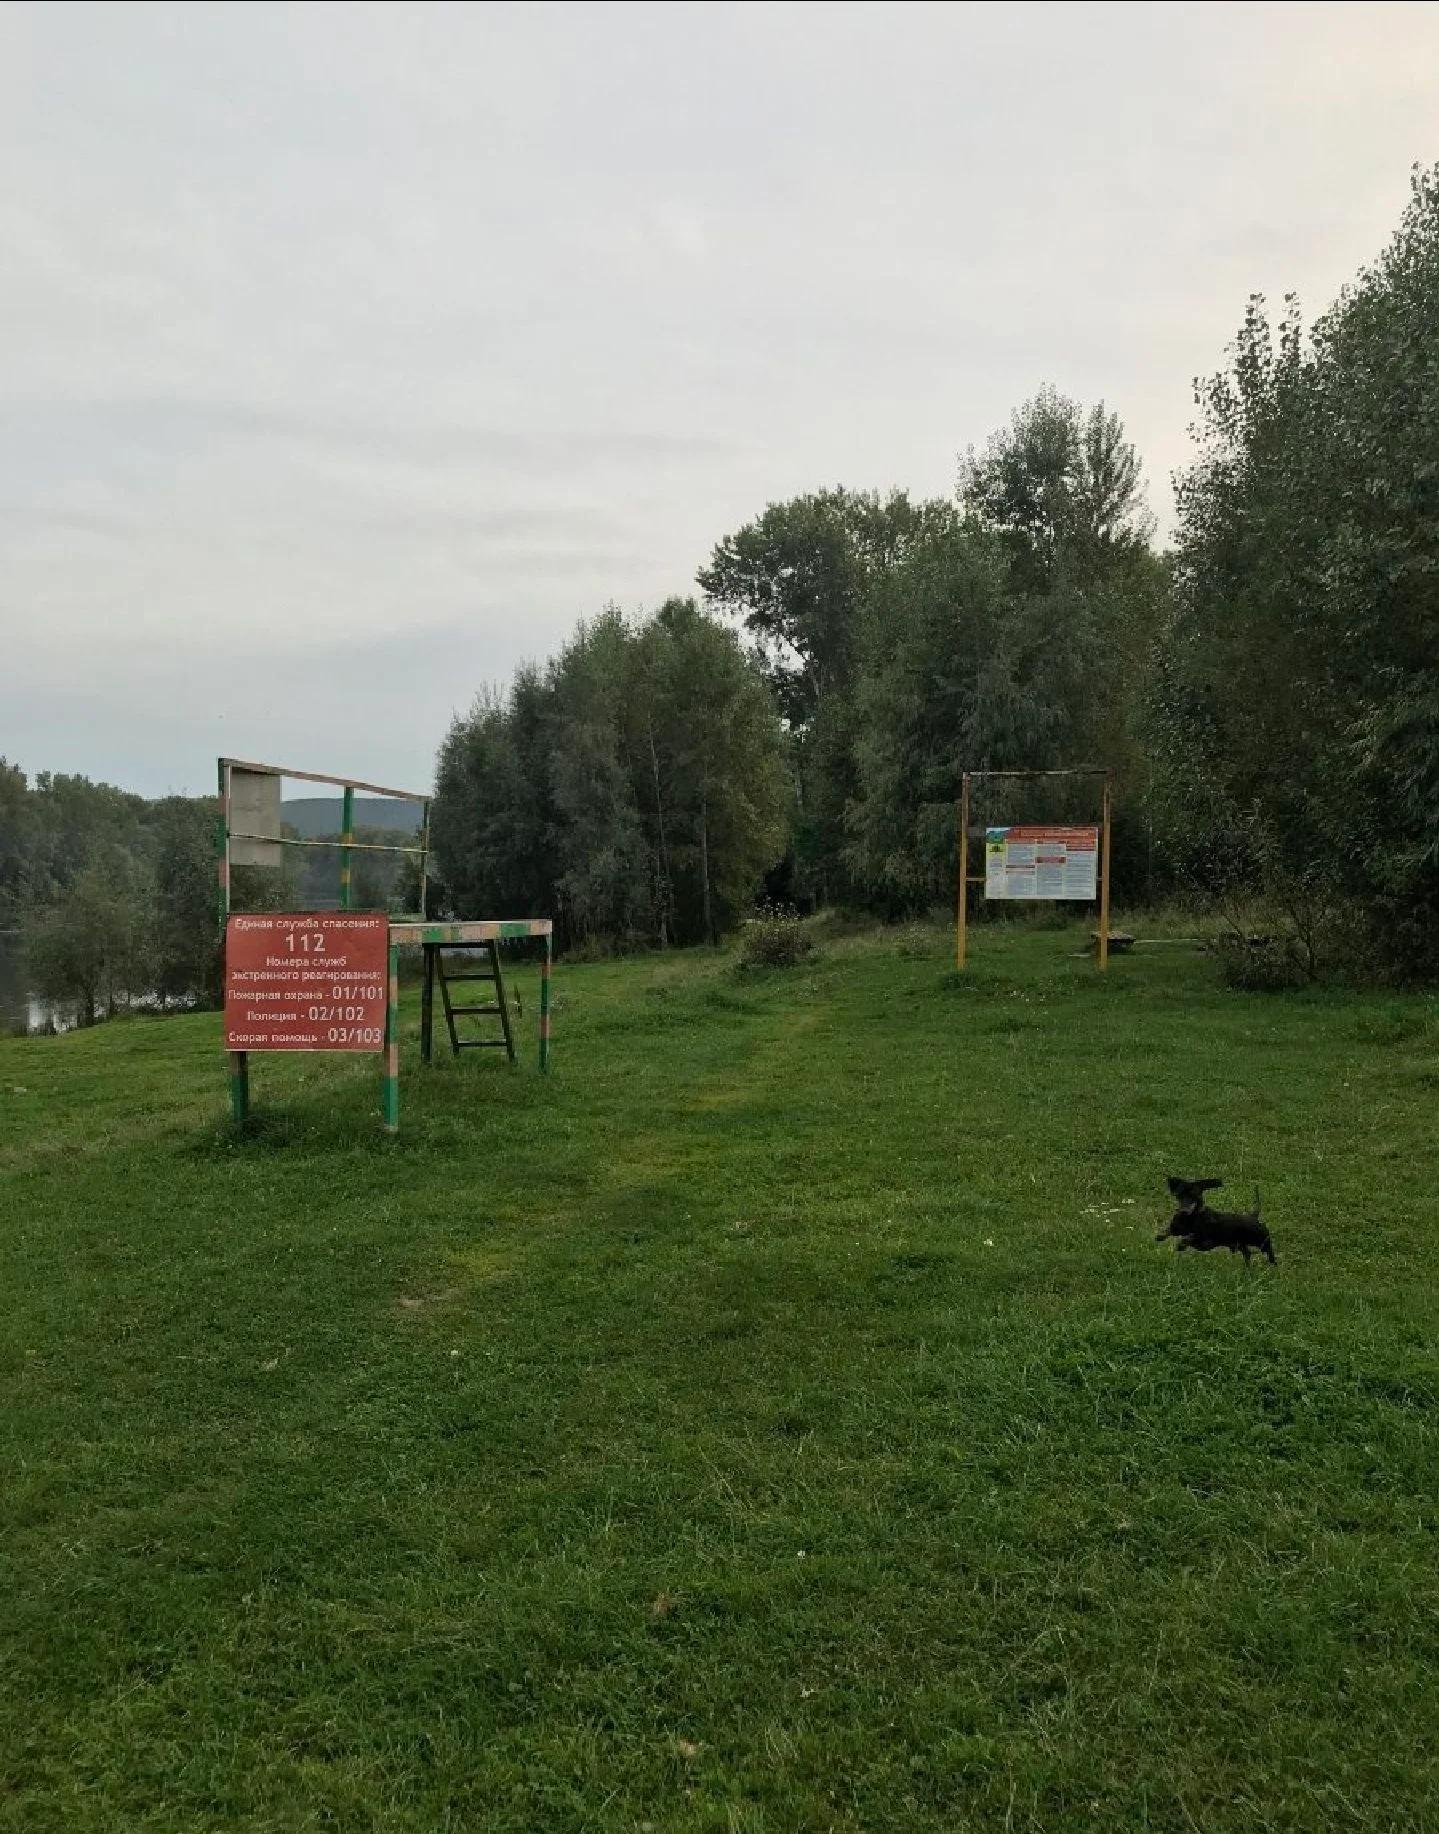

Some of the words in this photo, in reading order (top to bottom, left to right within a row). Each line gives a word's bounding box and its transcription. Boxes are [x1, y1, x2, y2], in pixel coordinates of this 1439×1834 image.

[234, 918, 272, 931] Единая
[276, 918, 318, 931] служба
[323, 920, 379, 928] спасения:
[285, 934, 326, 952] 112
[266, 956, 309, 968] Номера
[312, 956, 347, 968] служб
[232, 972, 299, 982] экстренного
[228, 989, 280, 1002] Пожарная
[284, 991, 322, 1002] охрана
[332, 987, 383, 1000] 01/101
[248, 1011, 297, 1021] Полиция
[309, 1007, 364, 1021] 02/102
[229, 1032, 268, 1043] Скорая
[272, 1034, 318, 1043] помощь
[328, 1028, 381, 1043] 03/103
